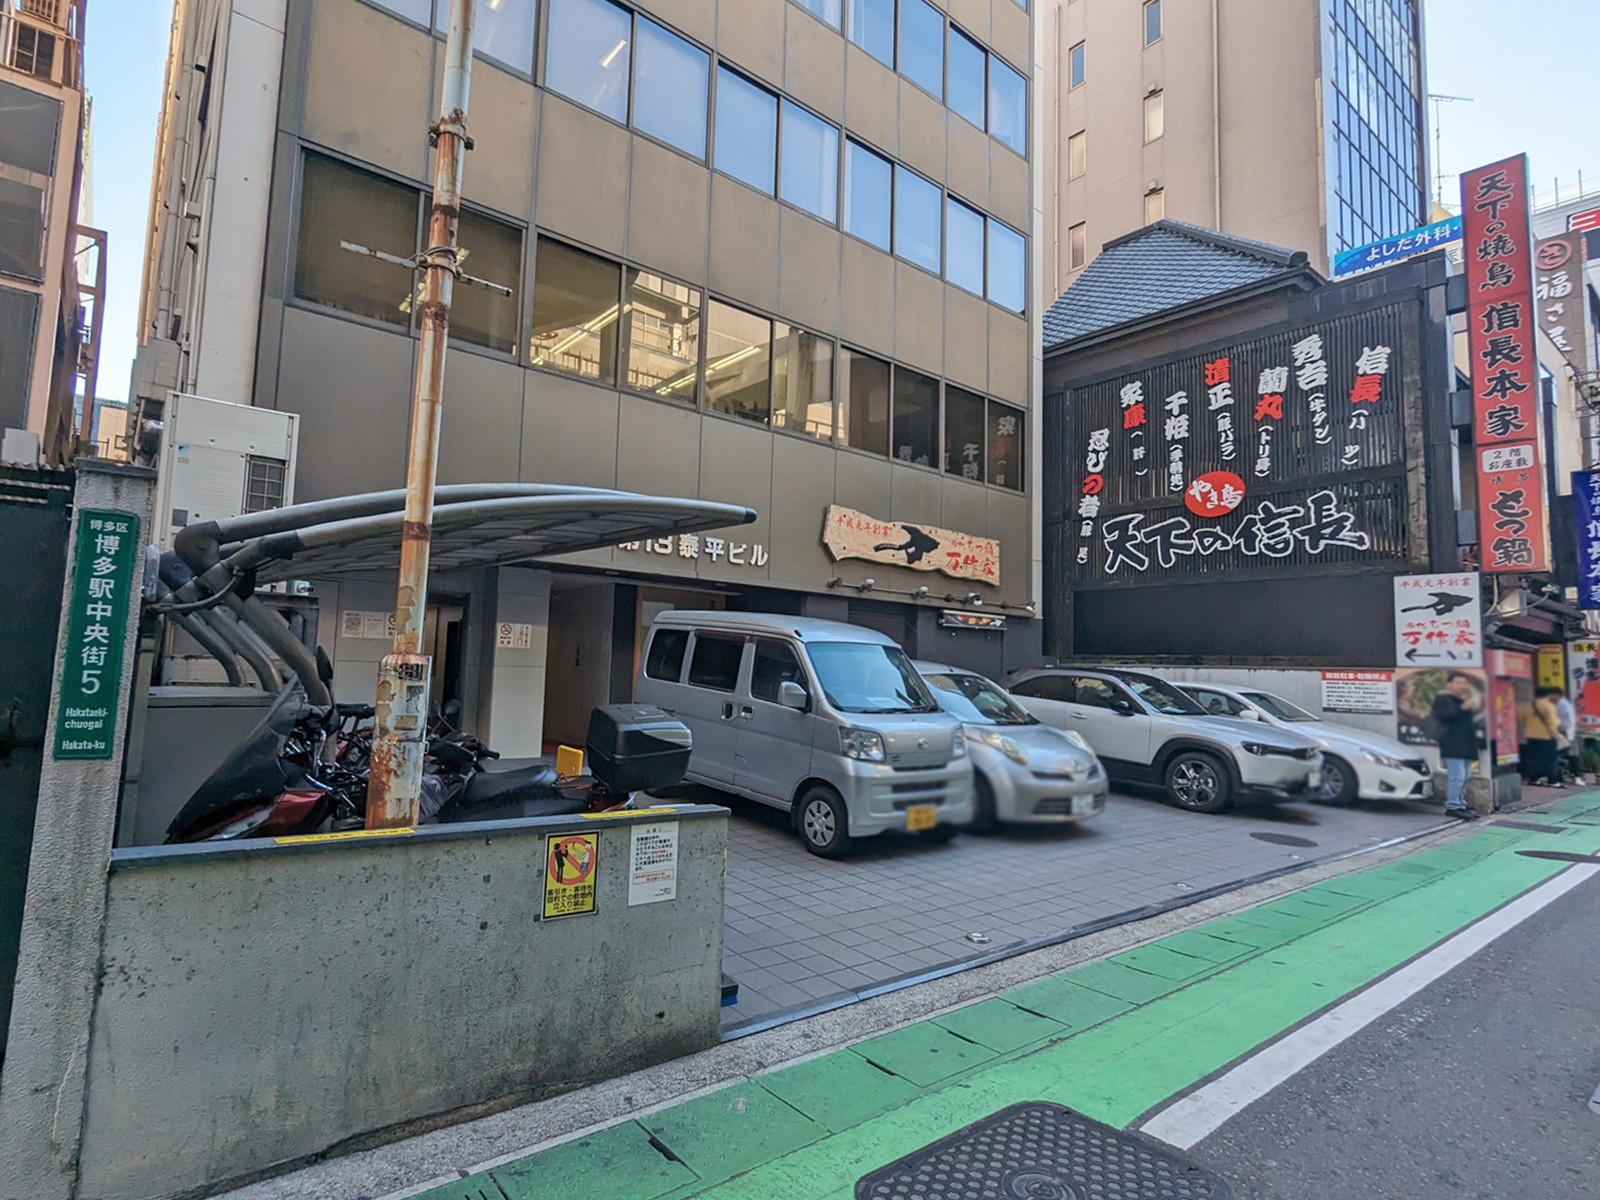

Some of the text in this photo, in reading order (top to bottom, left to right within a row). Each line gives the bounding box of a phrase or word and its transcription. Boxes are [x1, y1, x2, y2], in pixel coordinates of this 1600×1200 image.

[1475, 169, 1530, 440] 天下の焼鳥 信長本家
[1494, 448, 1521, 459] 2階
[1488, 457, 1528, 470] お座敷
[1187, 479, 1246, 510] やき鳥
[90, 519, 129, 533] 博多区
[1103, 490, 1370, 574] 天下の信長
[1489, 488, 1534, 567] もつ鍋
[1401, 630, 1475, 645] 万作家
[65, 707, 109, 718] Hakataeki-
[64, 719, 103, 730] chuogai
[62, 740, 106, 750] Hakata-ku
